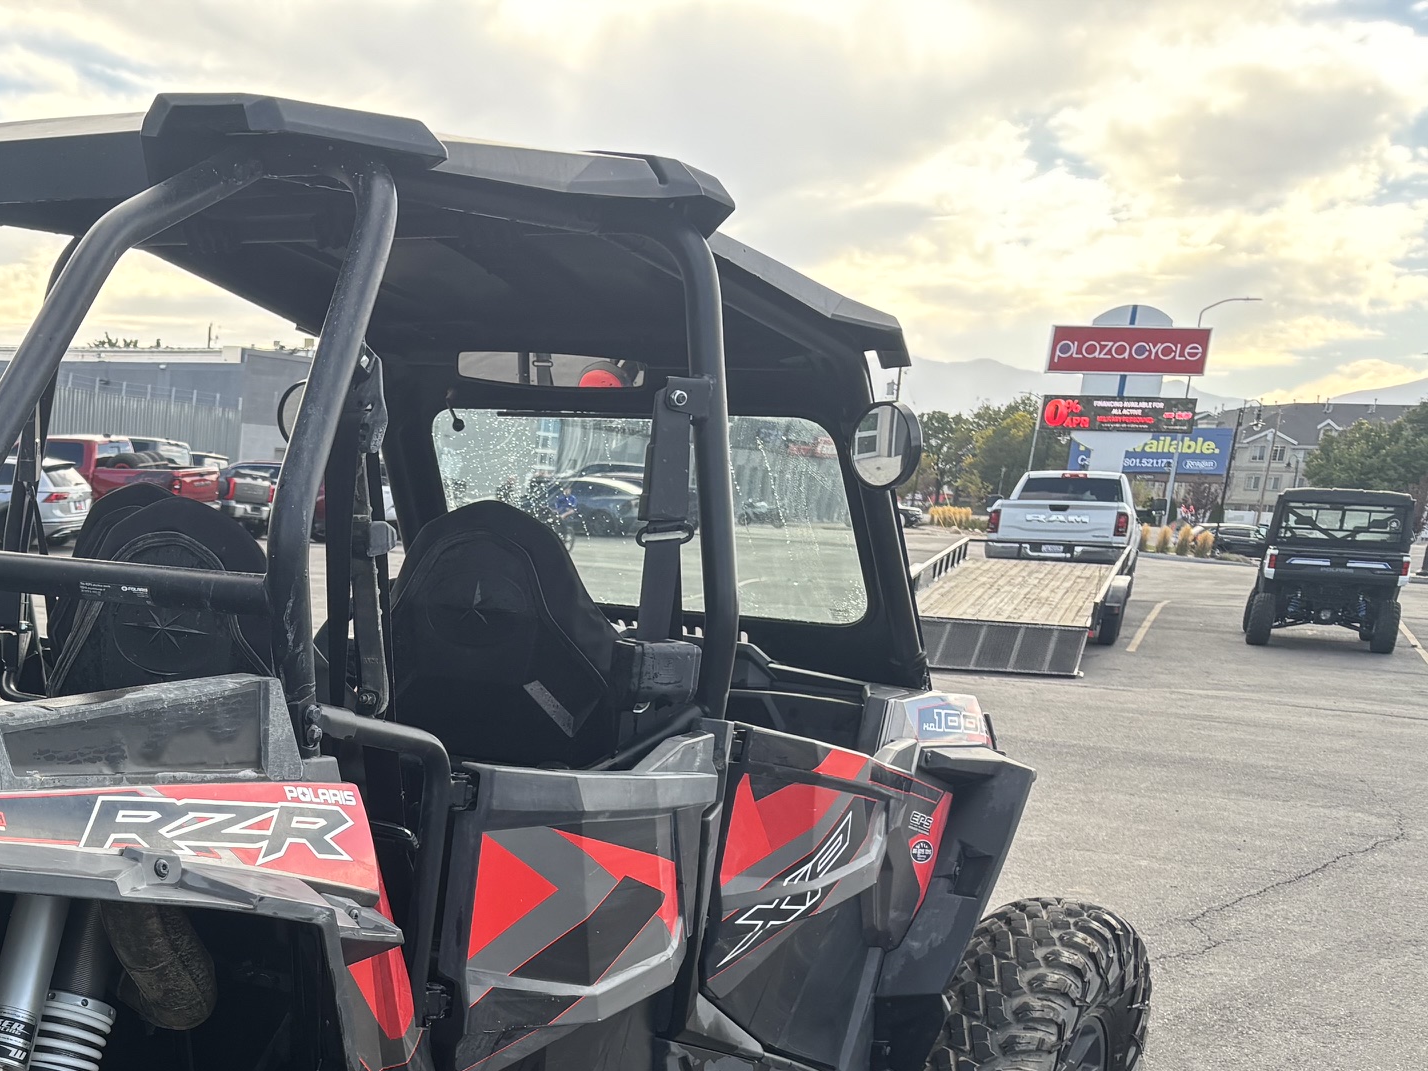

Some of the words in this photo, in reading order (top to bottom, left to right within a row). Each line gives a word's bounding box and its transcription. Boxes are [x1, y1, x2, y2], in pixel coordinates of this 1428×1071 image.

[1063, 416, 1090, 428] APR
[1129, 437, 1220, 454] vailable.
[1025, 514, 1089, 524] RAM
[283, 786, 356, 806] POLARIS
[910, 811, 933, 829] EPS
[79, 796, 354, 866] RZR
